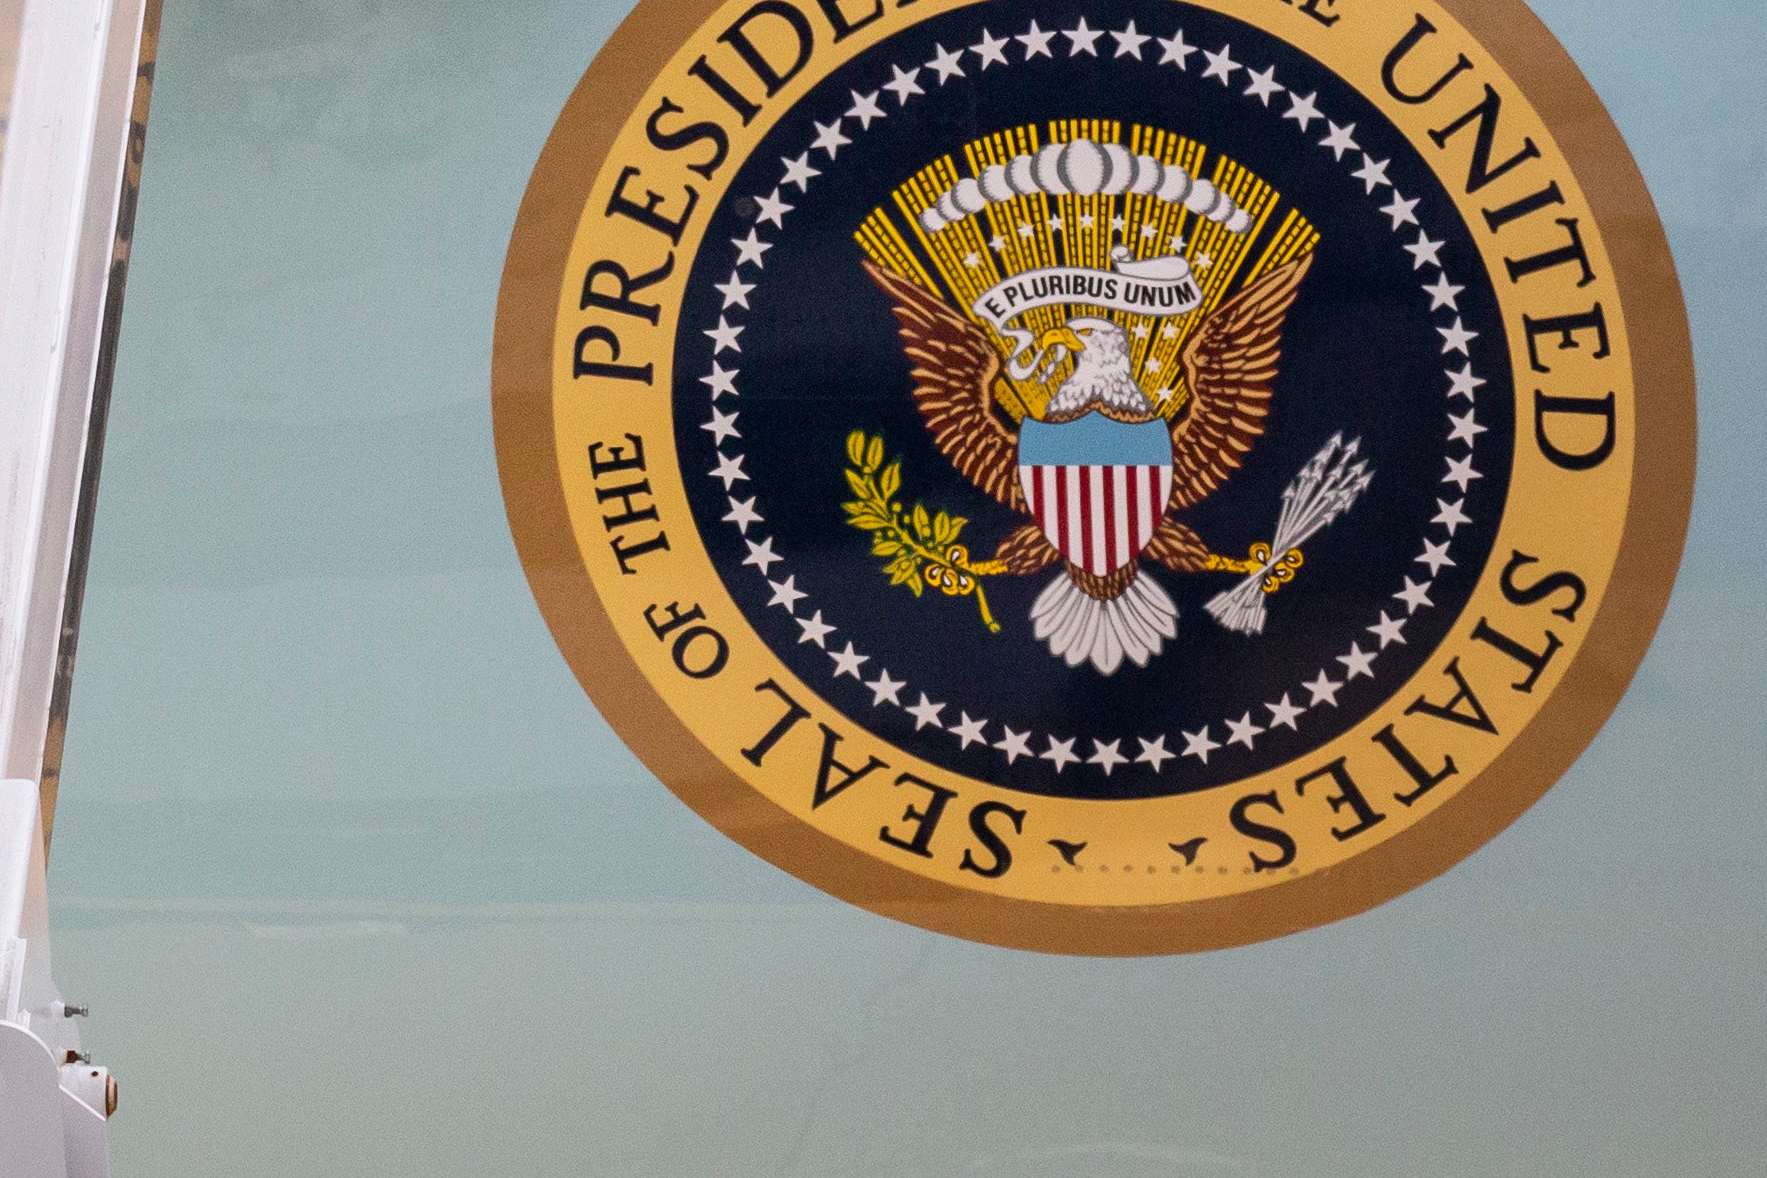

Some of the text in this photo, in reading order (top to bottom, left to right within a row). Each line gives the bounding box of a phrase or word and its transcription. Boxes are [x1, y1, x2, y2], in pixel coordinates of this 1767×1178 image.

[984, 274, 1197, 319] E PLURIBUS UNUM
[1381, 14, 1615, 471] UNITED
[589, 433, 670, 574] THE
[644, 602, 728, 678] OF
[1230, 550, 1586, 872] STATES
[741, 679, 1026, 878] SEAL
